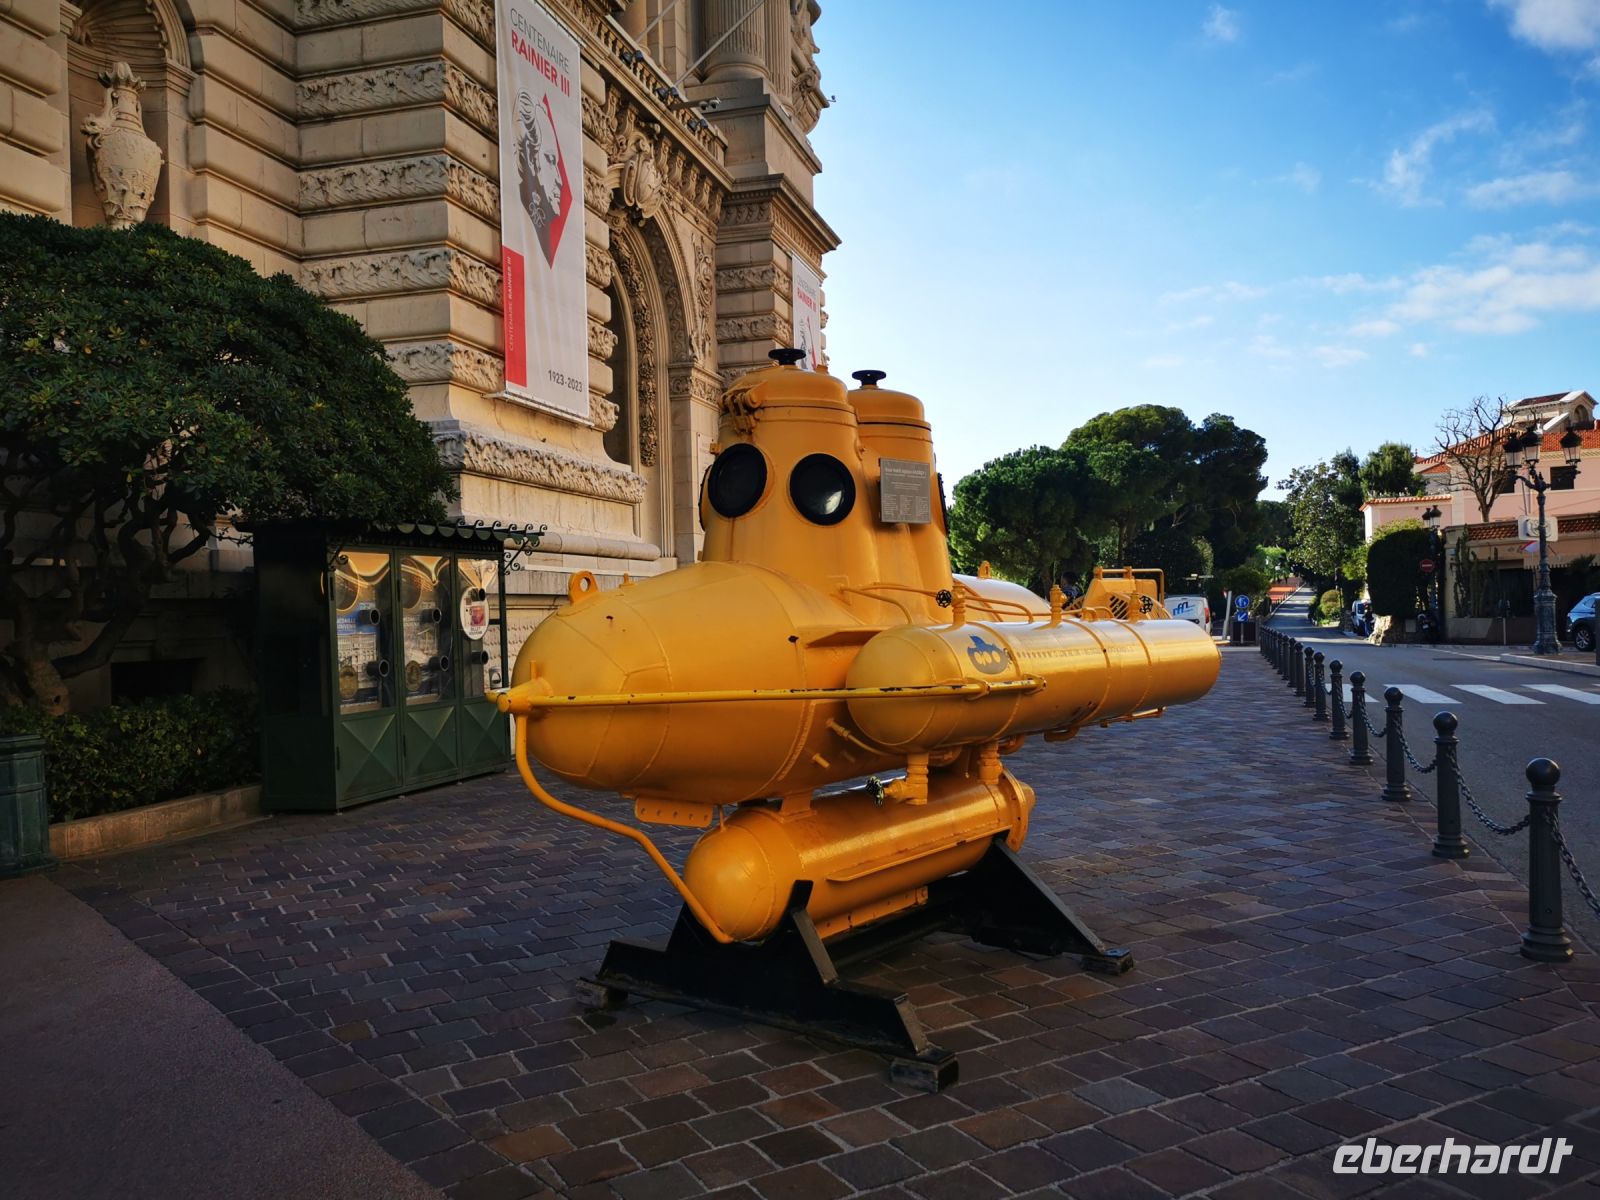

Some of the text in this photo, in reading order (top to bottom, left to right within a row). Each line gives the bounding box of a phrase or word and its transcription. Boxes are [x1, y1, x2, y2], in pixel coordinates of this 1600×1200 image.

[510, 8, 569, 73] CENTENAIRE
[511, 29, 570, 97] RAINIER III
